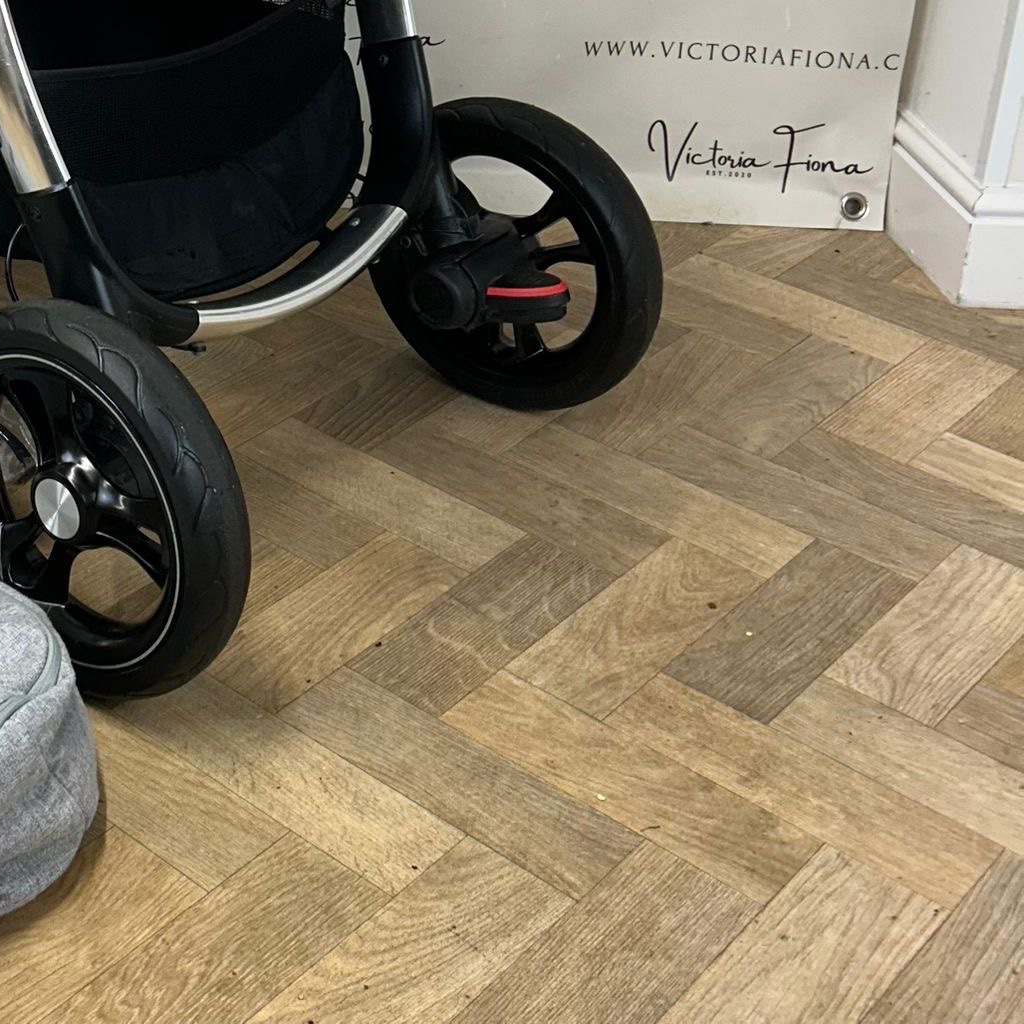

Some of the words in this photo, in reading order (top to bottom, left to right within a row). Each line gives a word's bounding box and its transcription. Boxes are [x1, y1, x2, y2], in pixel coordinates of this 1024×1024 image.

[584, 40, 901, 71] WWW.VICTORIAFIONA.C
[646, 119, 772, 183] Victoria
[772, 122, 875, 194] Fiona
